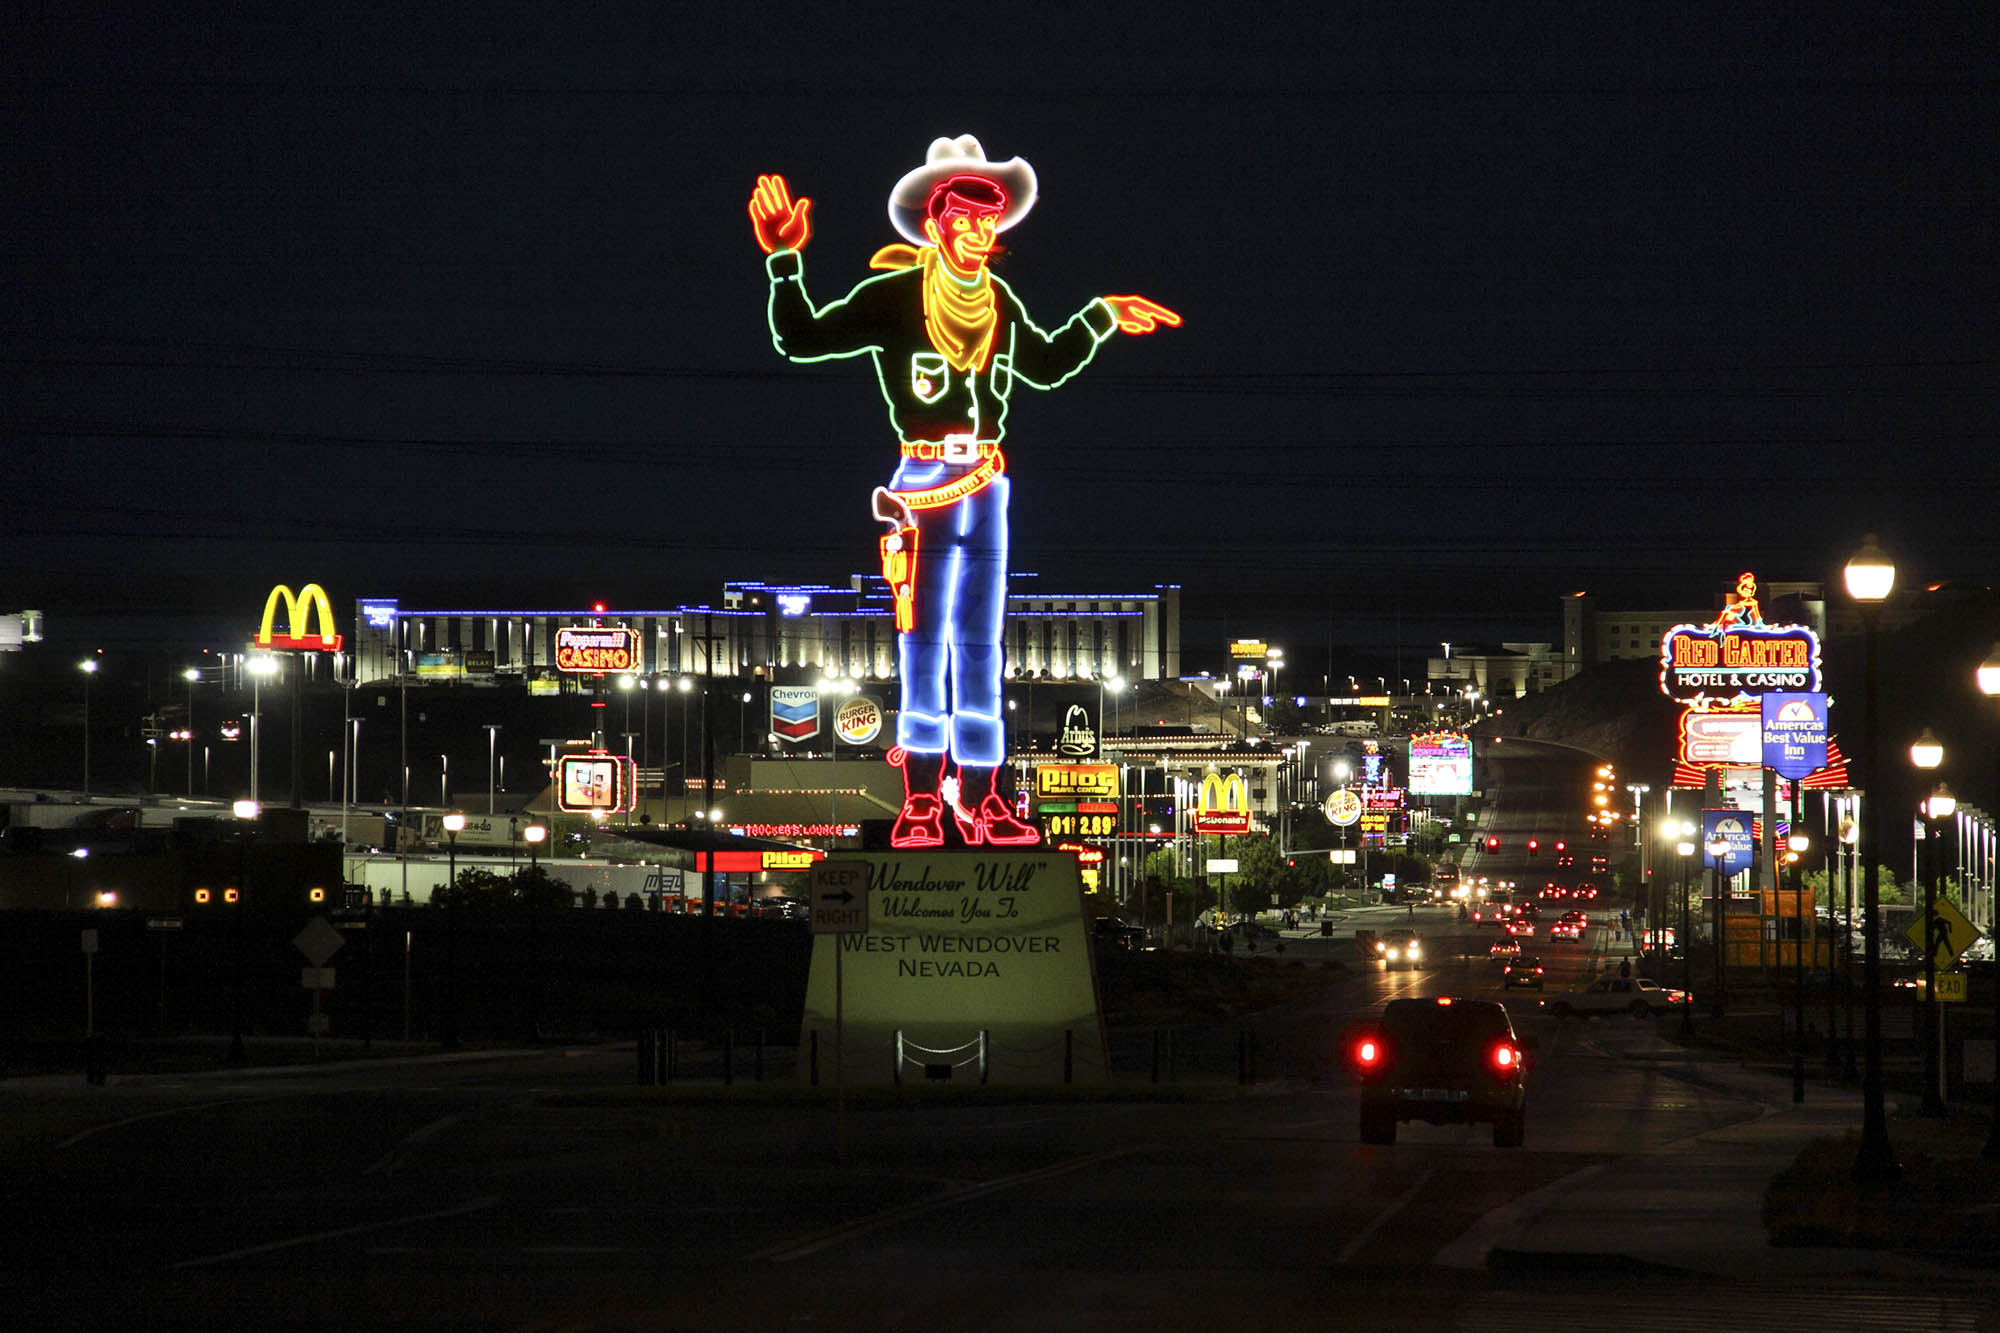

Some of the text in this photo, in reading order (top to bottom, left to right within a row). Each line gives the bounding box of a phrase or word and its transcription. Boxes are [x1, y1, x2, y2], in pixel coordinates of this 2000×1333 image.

[560, 632, 625, 650] Peppermill
[559, 648, 629, 668] CASINO
[1673, 635, 1809, 668] RED GARTER
[1678, 674, 1806, 686] HOTEL & CASINO
[772, 689, 818, 699] Chevron
[840, 705, 875, 721] BURGER
[842, 714, 876, 733] KING
[1765, 719, 1824, 731] Americas
[1764, 732, 1826, 743] Best Value
[1784, 745, 1805, 755] Inn
[1042, 769, 1113, 791] Pilot
[1198, 816, 1247, 824] McDonald's
[745, 824, 843, 836] TRUCKER'S LOUNGE
[762, 851, 814, 869] Pilot
[818, 871, 859, 885] KEEP
[867, 863, 966, 892] Wendover
[816, 909, 862, 924] RIGHT
[882, 896, 1019, 923] Welcomes You To
[842, 934, 1061, 953] WEST WENDOVER
[898, 959, 1001, 977] NEVADA
